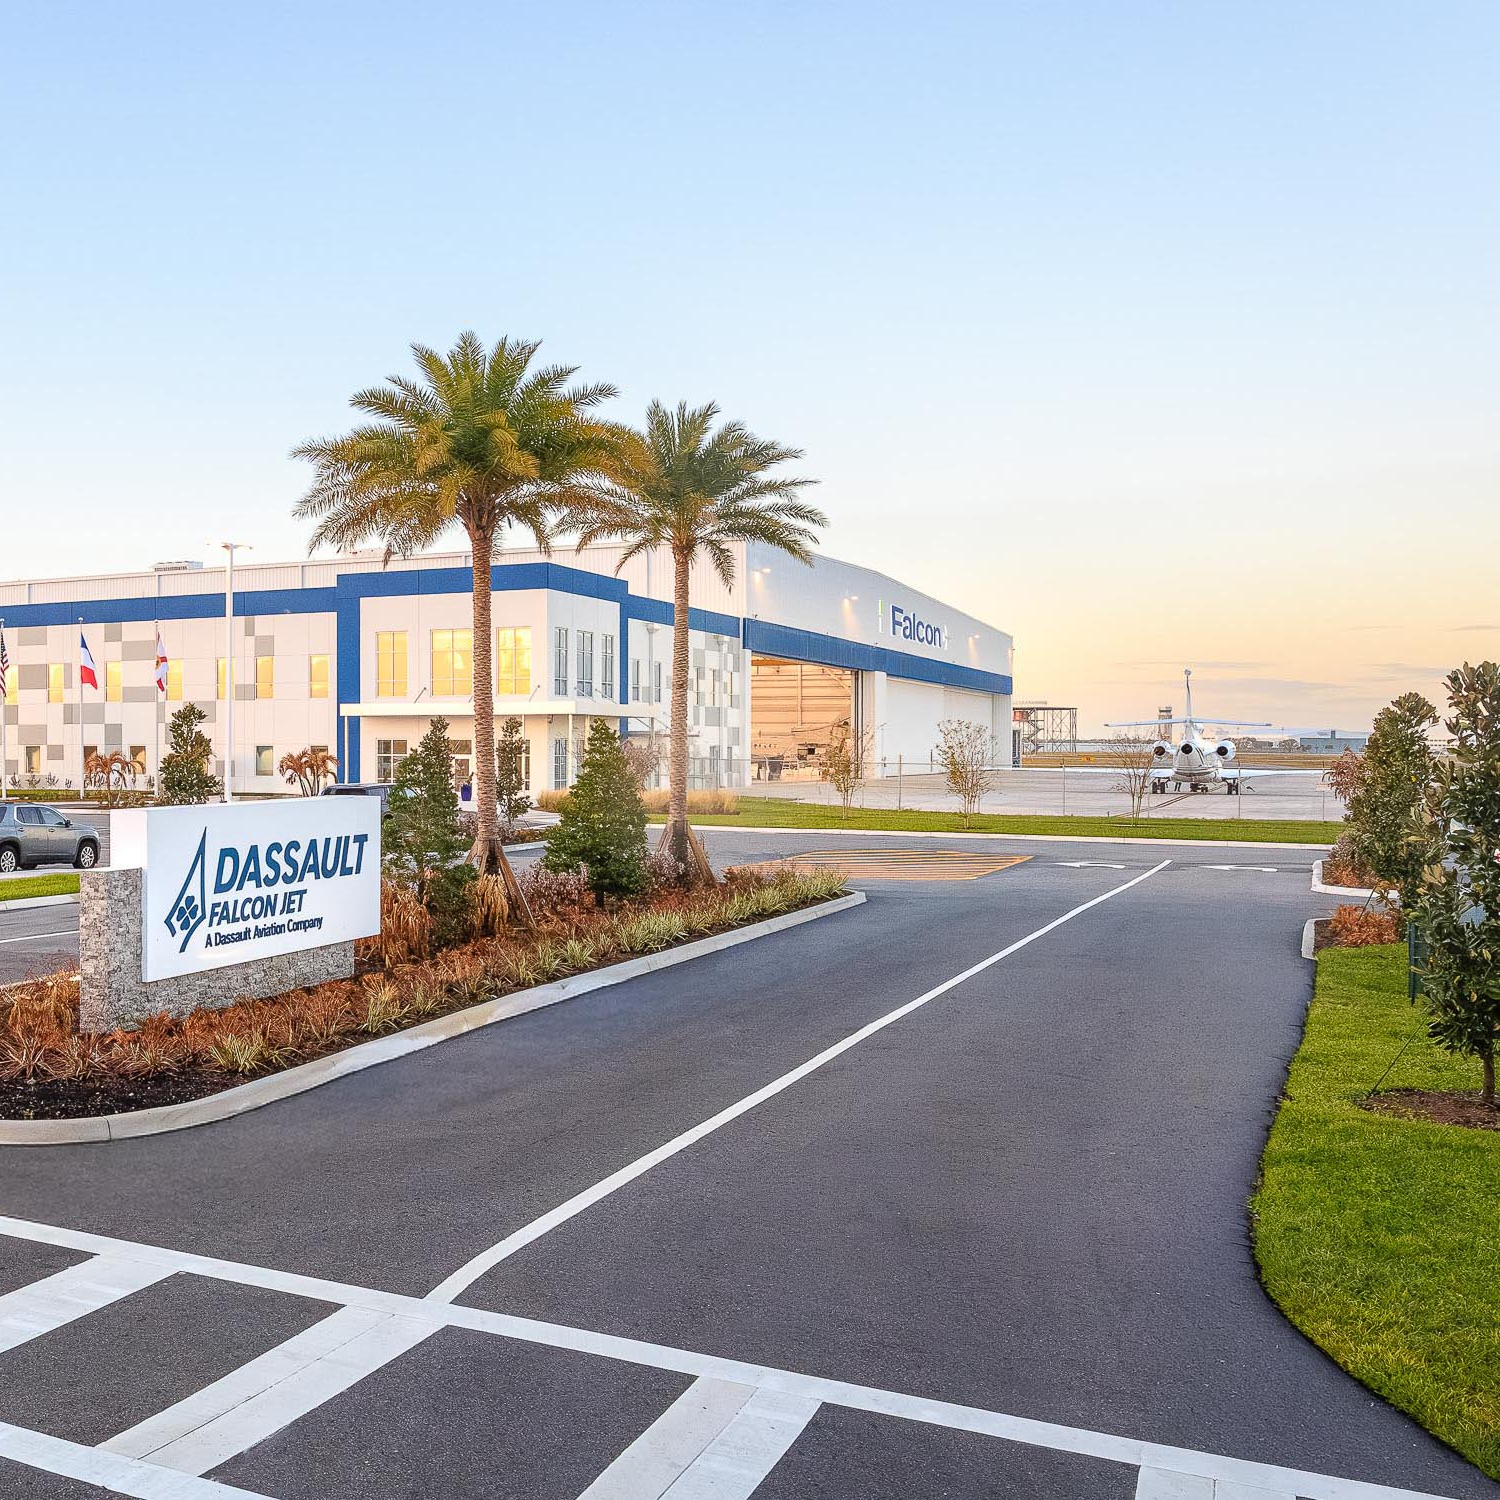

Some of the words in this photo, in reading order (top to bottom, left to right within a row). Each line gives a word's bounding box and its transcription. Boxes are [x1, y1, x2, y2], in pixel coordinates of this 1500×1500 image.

[891, 604, 942, 648] Falcon
[213, 834, 368, 894] DASSAULT
[208, 895, 278, 927] FALCON
[279, 889, 307, 915] JET
[204, 933, 213, 948] A
[214, 927, 251, 946] Dassault
[253, 922, 285, 939] Aviation
[287, 917, 323, 932] Company
